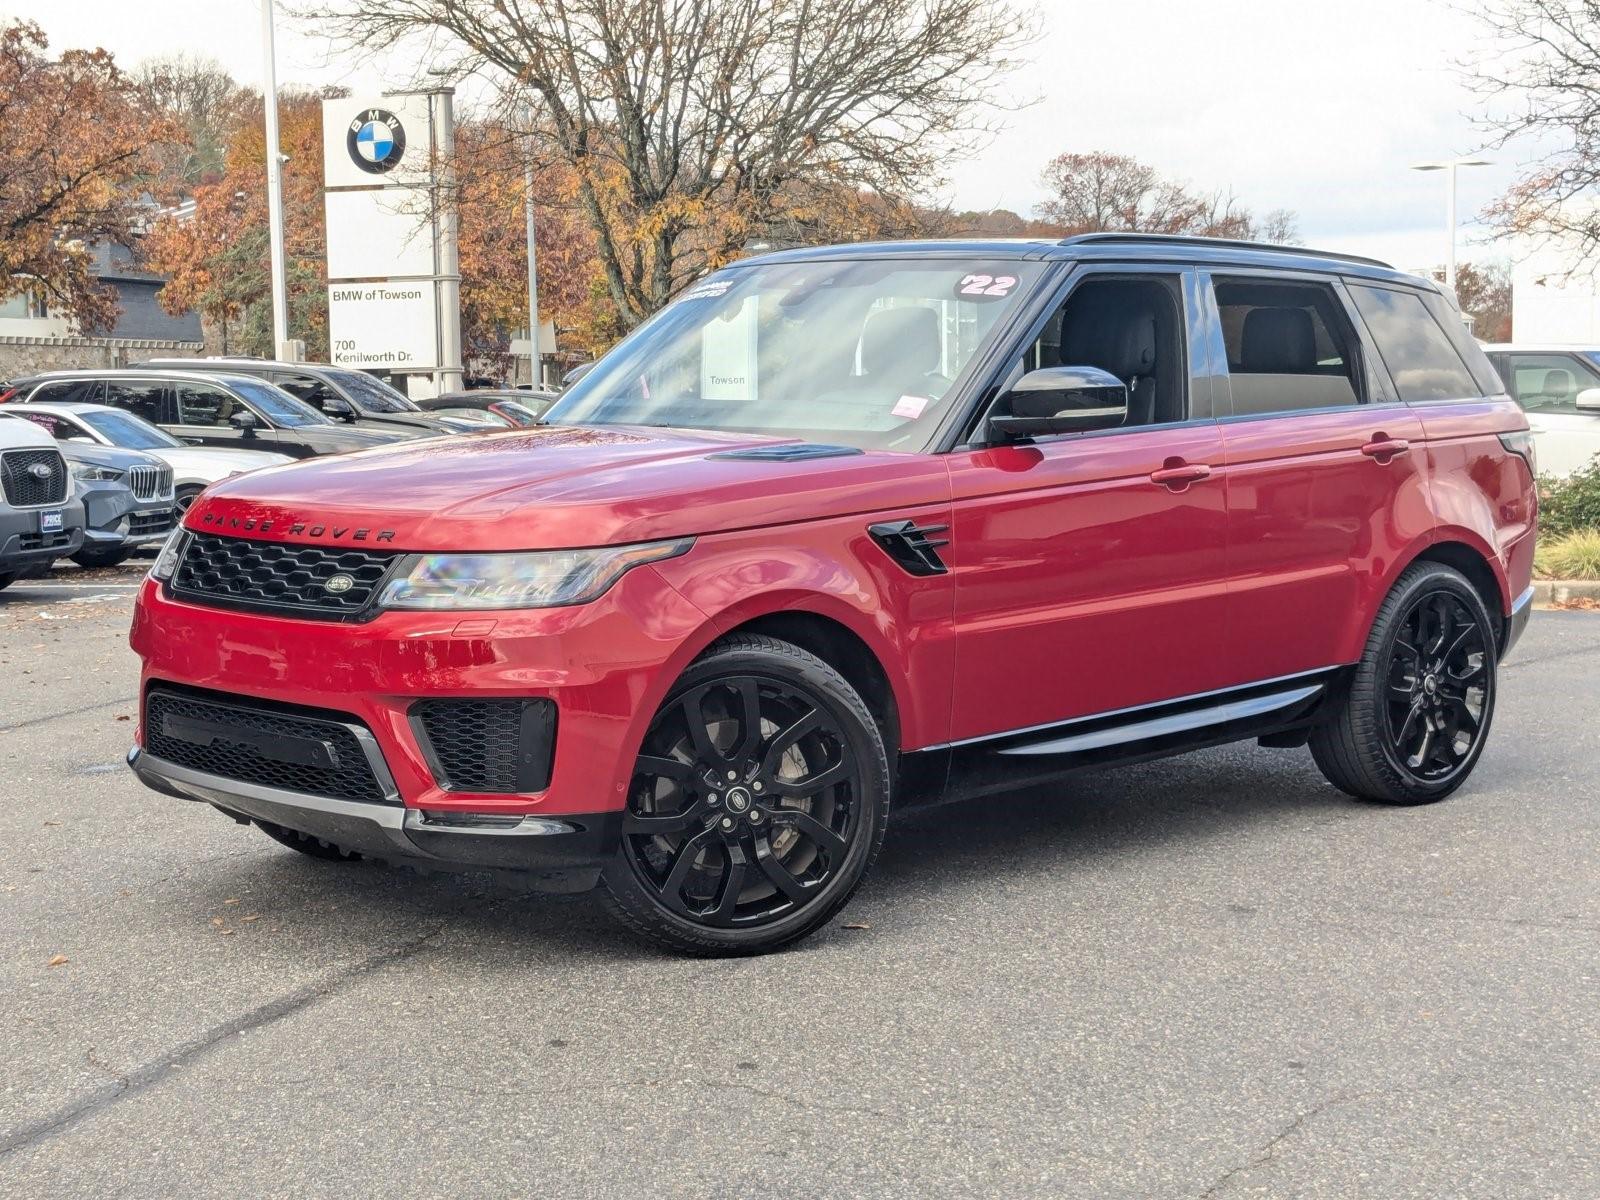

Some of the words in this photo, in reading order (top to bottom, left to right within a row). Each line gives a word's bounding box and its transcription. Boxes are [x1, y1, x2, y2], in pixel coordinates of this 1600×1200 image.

[351, 110, 399, 133] BMW
[333, 290, 363, 301] BMW
[365, 290, 377, 300] of
[378, 289, 421, 300] Towson
[335, 340, 356, 351] 700
[335, 351, 395, 363] Kenilworth
[398, 351, 413, 361] Dr.
[710, 376, 745, 385] Towson
[203, 513, 275, 532] RANGE
[288, 523, 396, 542] ROVER
